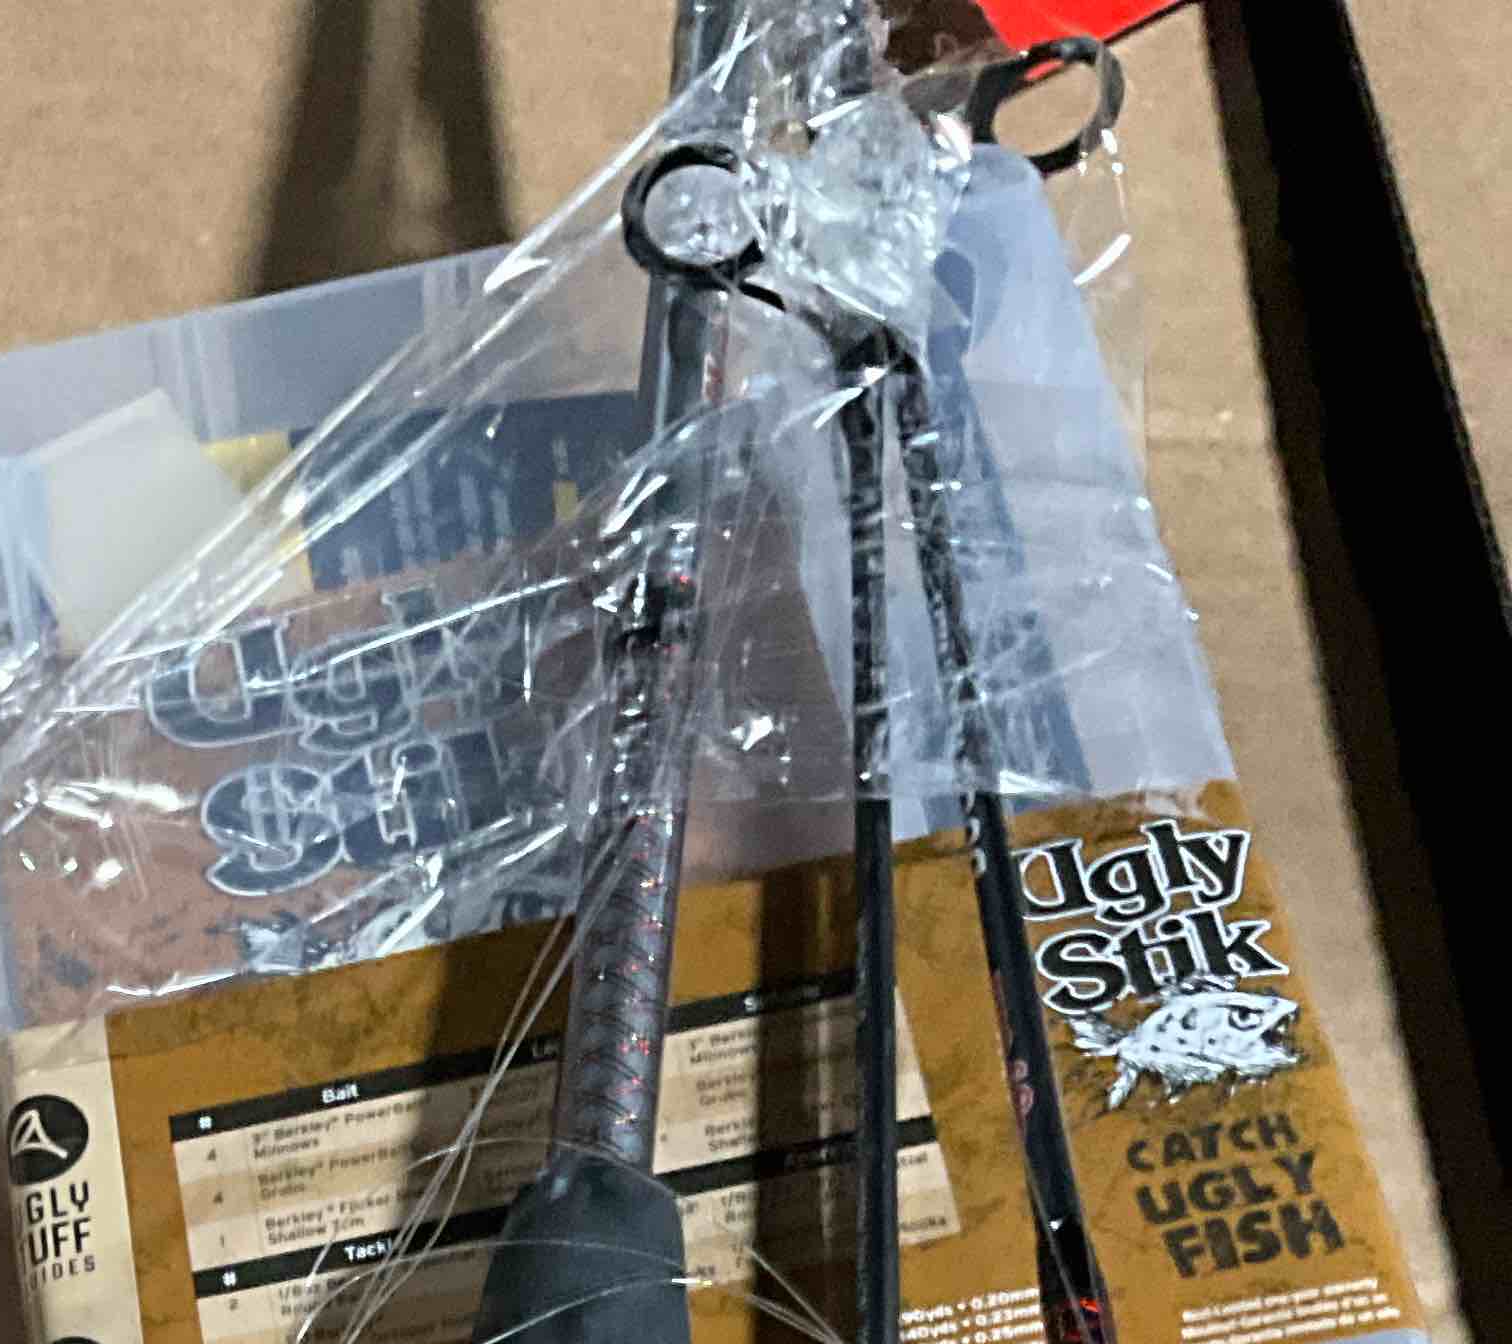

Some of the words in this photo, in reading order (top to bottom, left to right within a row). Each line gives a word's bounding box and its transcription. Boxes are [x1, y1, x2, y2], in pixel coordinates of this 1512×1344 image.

[1011, 818, 1251, 925] Ugly
[1037, 905, 1290, 1015] Stik
[322, 1083, 359, 1104] Bait
[1127, 1113, 1300, 1172] CATCH
[18, 1181, 89, 1226] GLY
[1136, 1150, 1316, 1224] UGLY
[22, 1217, 92, 1268] UFF
[344, 1236, 394, 1262] Tackl
[1162, 1200, 1345, 1278] FISH
[24, 1255, 96, 1291] UIDES
